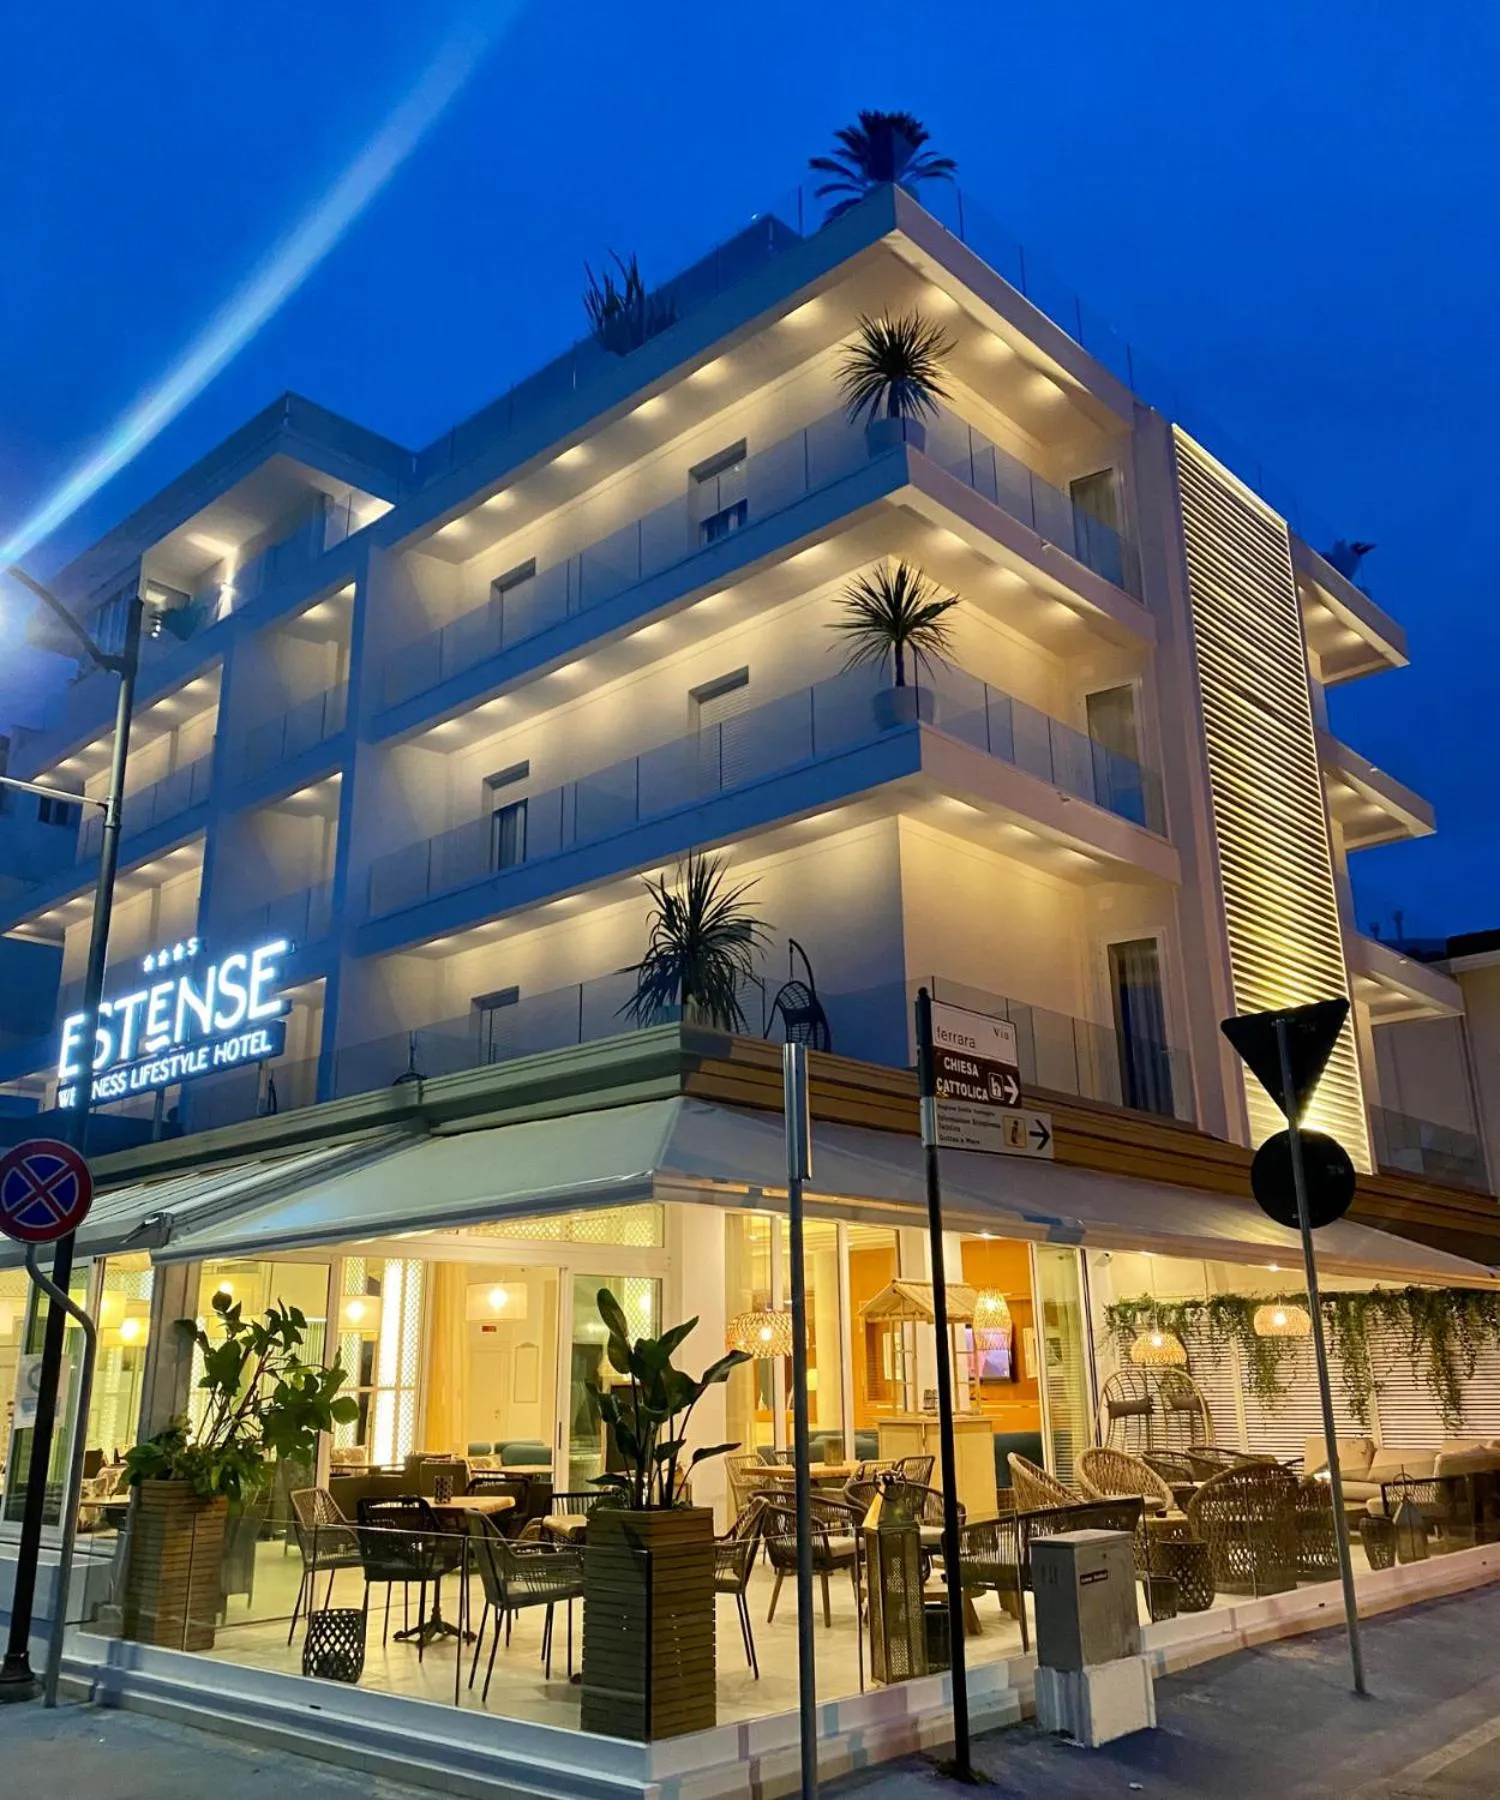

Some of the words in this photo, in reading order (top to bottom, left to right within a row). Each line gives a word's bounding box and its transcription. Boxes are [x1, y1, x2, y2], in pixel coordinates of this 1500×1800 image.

[58, 940, 288, 1079] ESTENSE
[130, 1047, 209, 1090] LIFESTYLE
[213, 1030, 272, 1066] HOTEL
[943, 1056, 979, 1078] CHIESA
[936, 1078, 989, 1101] CATTOLICA
